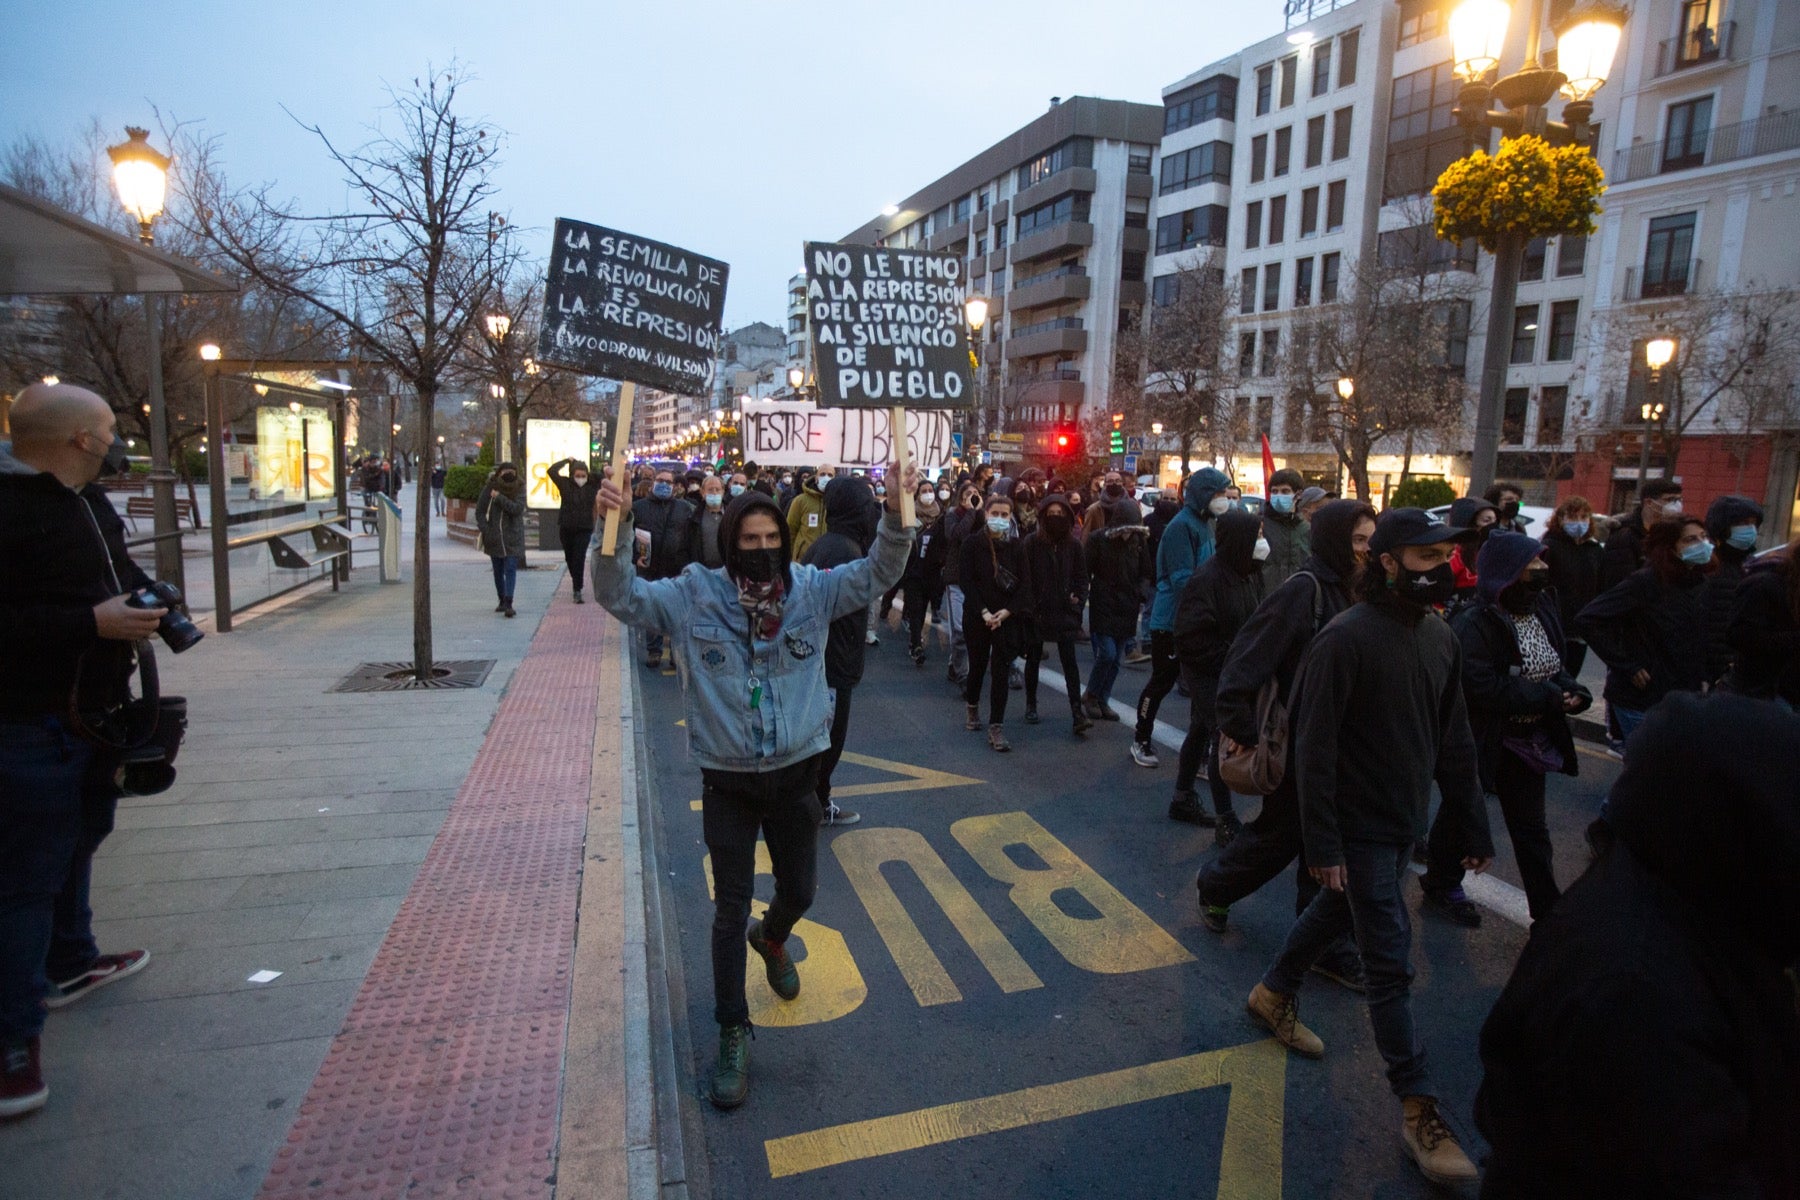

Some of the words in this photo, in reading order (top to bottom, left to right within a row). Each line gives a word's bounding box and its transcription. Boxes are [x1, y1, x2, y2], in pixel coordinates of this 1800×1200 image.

[565, 229, 590, 250] LA
[600, 236, 687, 277] SEMILLA
[699, 264, 720, 285] DE
[815, 251, 851, 278] NO
[864, 253, 890, 277] LE
[898, 255, 959, 280] TEMO
[563, 257, 587, 276] LA
[598, 262, 710, 310] REVOLUCIÓN
[612, 288, 639, 307] ES
[808, 279, 824, 300] A
[829, 280, 858, 301] LA
[863, 279, 965, 306] REPRESIÓN
[558, 294, 586, 315] LA
[603, 303, 718, 350] REPRESIÓN
[815, 303, 854, 322] DEL
[819, 324, 847, 345] AL
[852, 323, 957, 348] SILENCIO
[556, 324, 650, 363] (WOODROW
[657, 352, 714, 388] WILSON)
[836, 347, 866, 366] DE
[895, 346, 924, 368] MI
[839, 369, 963, 399] PUEBLO
